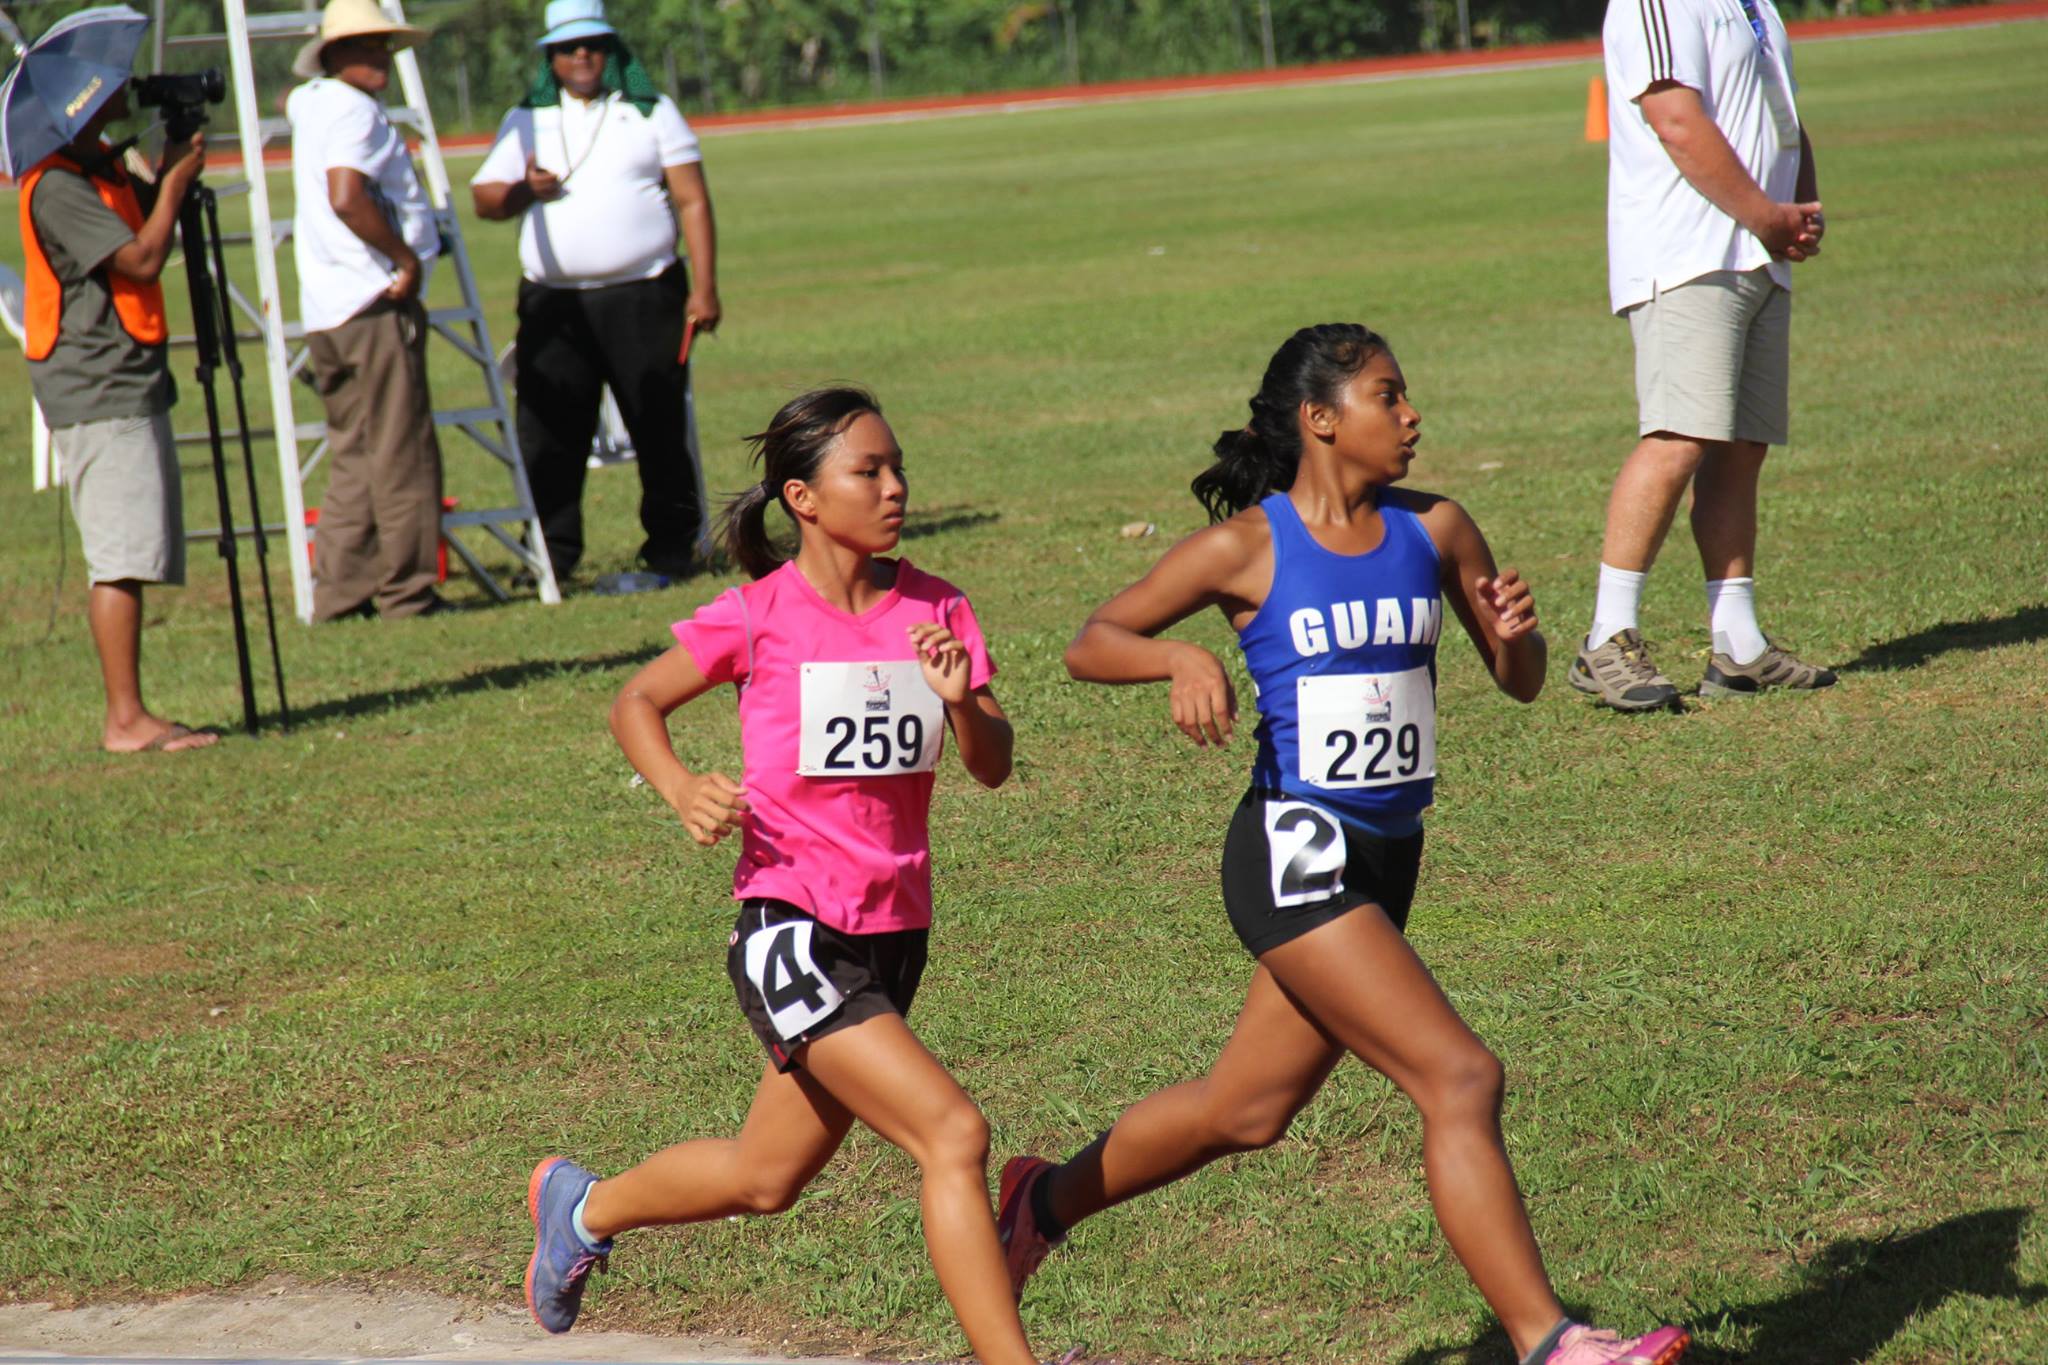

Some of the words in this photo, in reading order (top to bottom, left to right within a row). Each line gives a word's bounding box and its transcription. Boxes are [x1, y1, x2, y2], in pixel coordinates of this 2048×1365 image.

[1289, 597, 1441, 657] GUAM
[824, 714, 923, 770] 259
[1325, 723, 1420, 783] 229
[1273, 807, 1337, 898] 2
[762, 926, 827, 1015] 4
